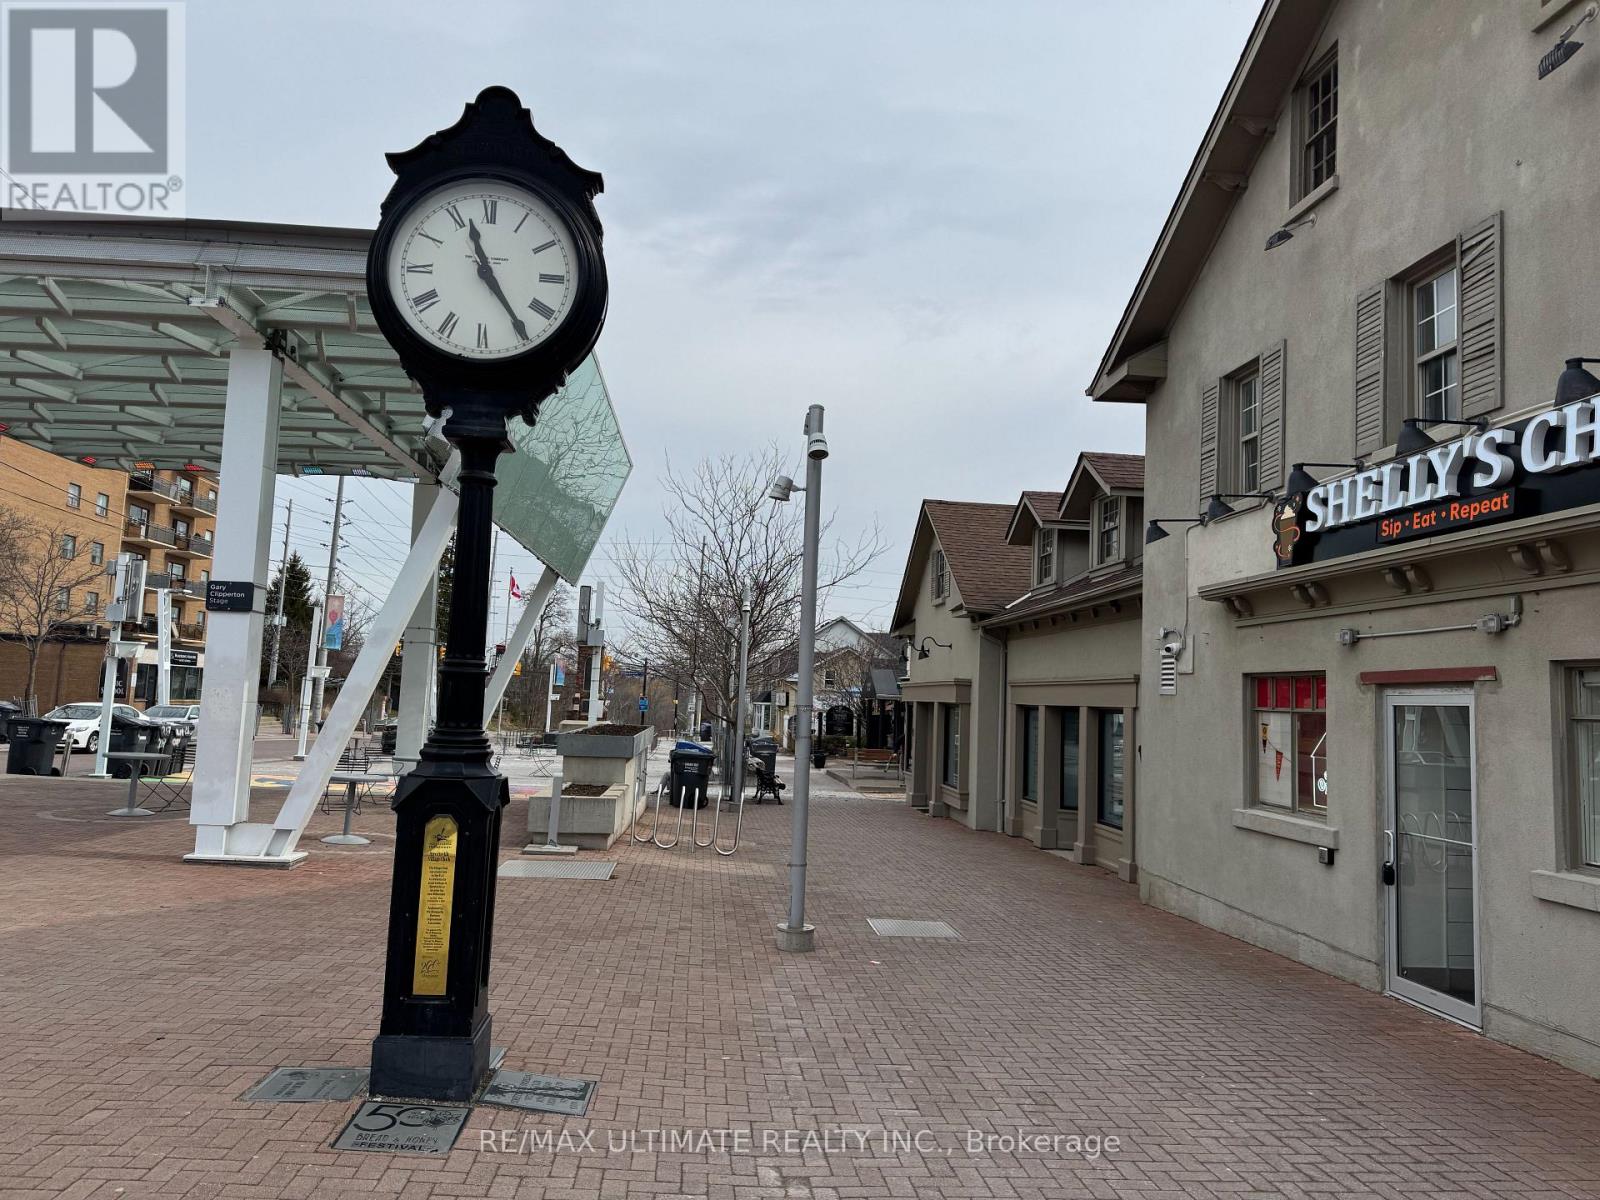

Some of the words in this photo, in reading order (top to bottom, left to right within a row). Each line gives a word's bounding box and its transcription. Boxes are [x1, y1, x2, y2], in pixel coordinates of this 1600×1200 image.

[481, 199, 498, 225] XII
[1305, 429, 1516, 532] SHELLY'S
[1381, 519, 1402, 540] Sip
[1412, 509, 1436, 530] Eat
[1449, 492, 1511, 523] Repeat
[210, 584, 226, 592] Gary
[209, 597, 229, 605] Stage
[354, 1133, 390, 1143] BREAD
[358, 1141, 427, 1152] FESTIVAL
